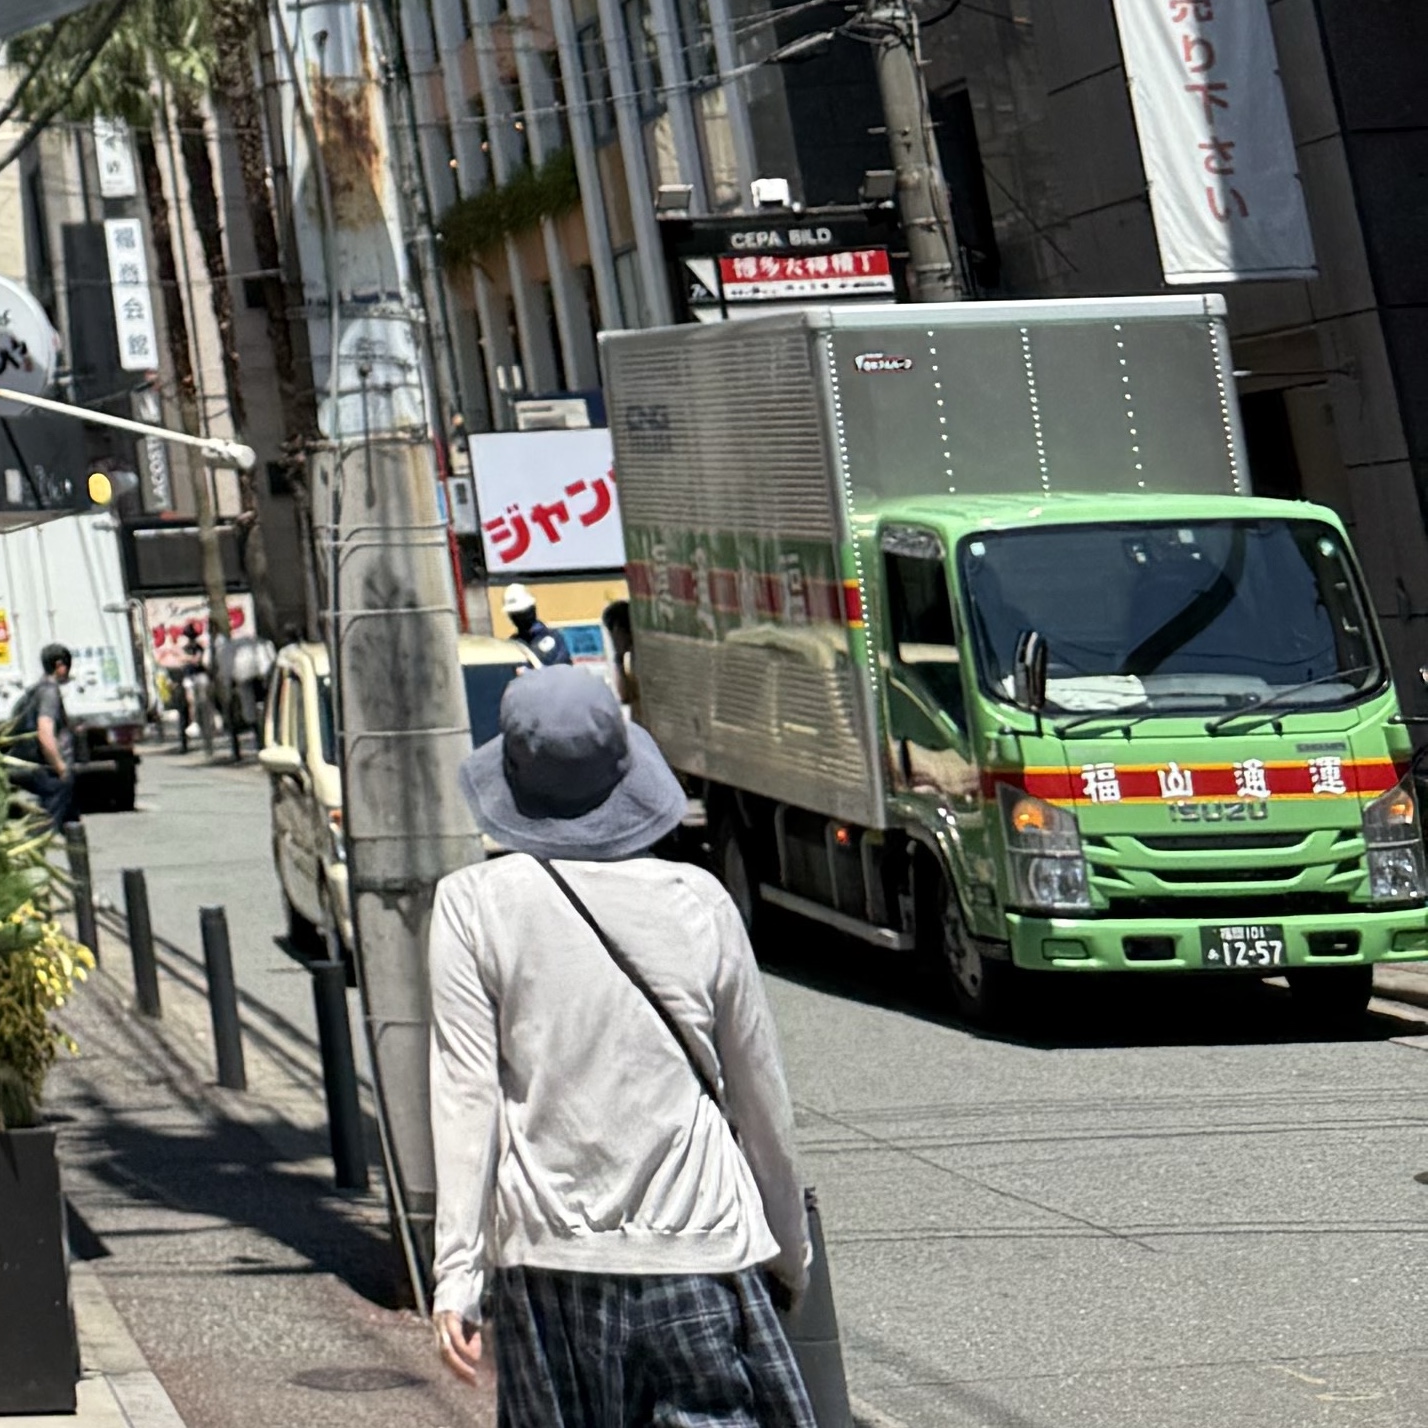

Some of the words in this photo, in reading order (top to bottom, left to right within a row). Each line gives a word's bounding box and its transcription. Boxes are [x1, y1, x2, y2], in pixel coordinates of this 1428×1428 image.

[730, 230, 784, 249] CEPA
[788, 227, 832, 246] BILD
[481, 468, 617, 565] ジャン
[1080, 756, 1347, 804] 福山通運
[1169, 800, 1269, 823] ISUZU
